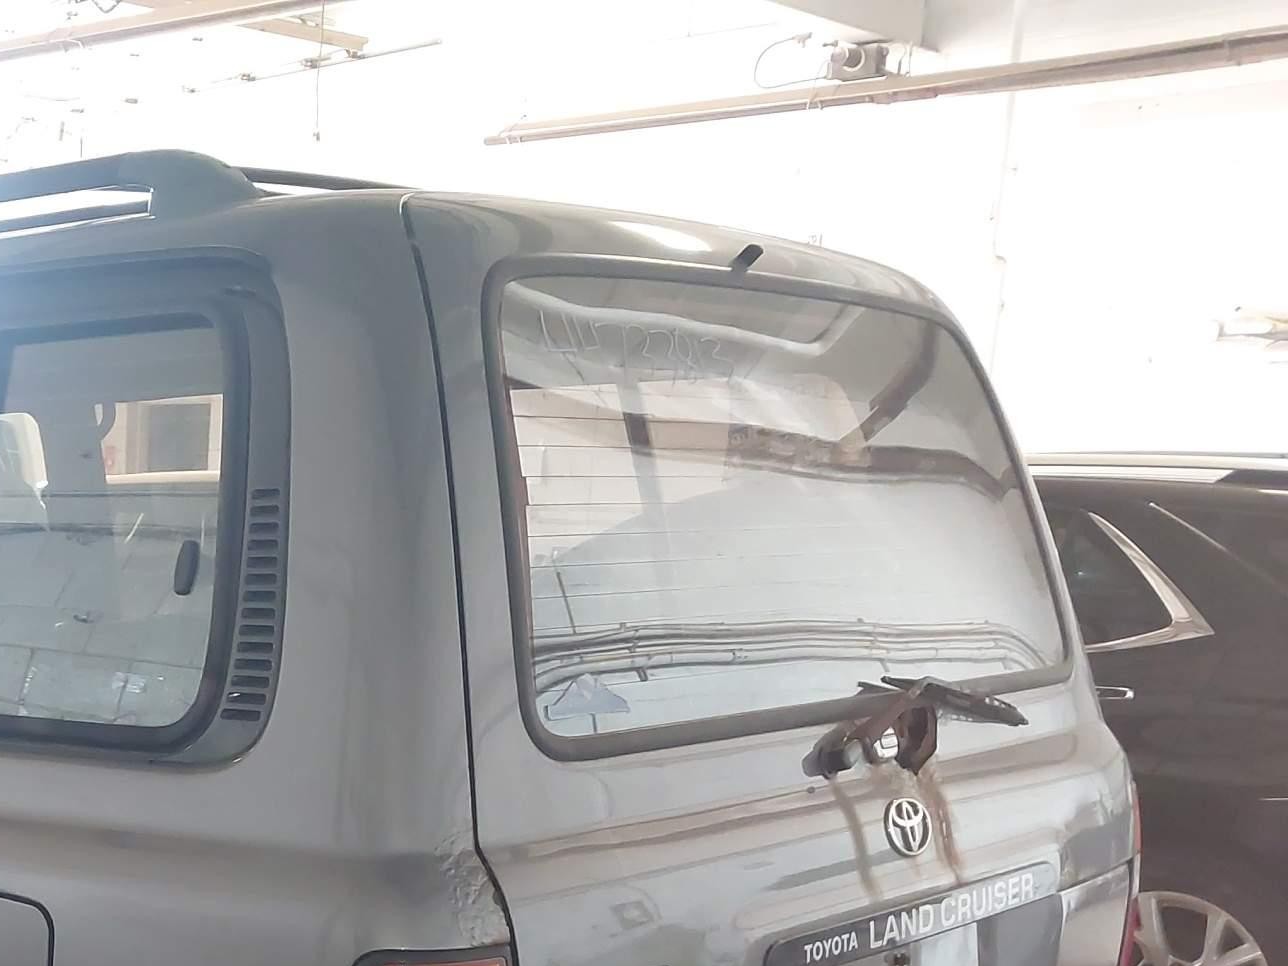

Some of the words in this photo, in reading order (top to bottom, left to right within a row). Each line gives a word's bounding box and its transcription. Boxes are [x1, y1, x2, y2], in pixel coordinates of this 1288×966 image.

[804, 932, 859, 964] TOYOTA
[869, 903, 935, 949] LAND
[940, 872, 1034, 926] CRUISER
